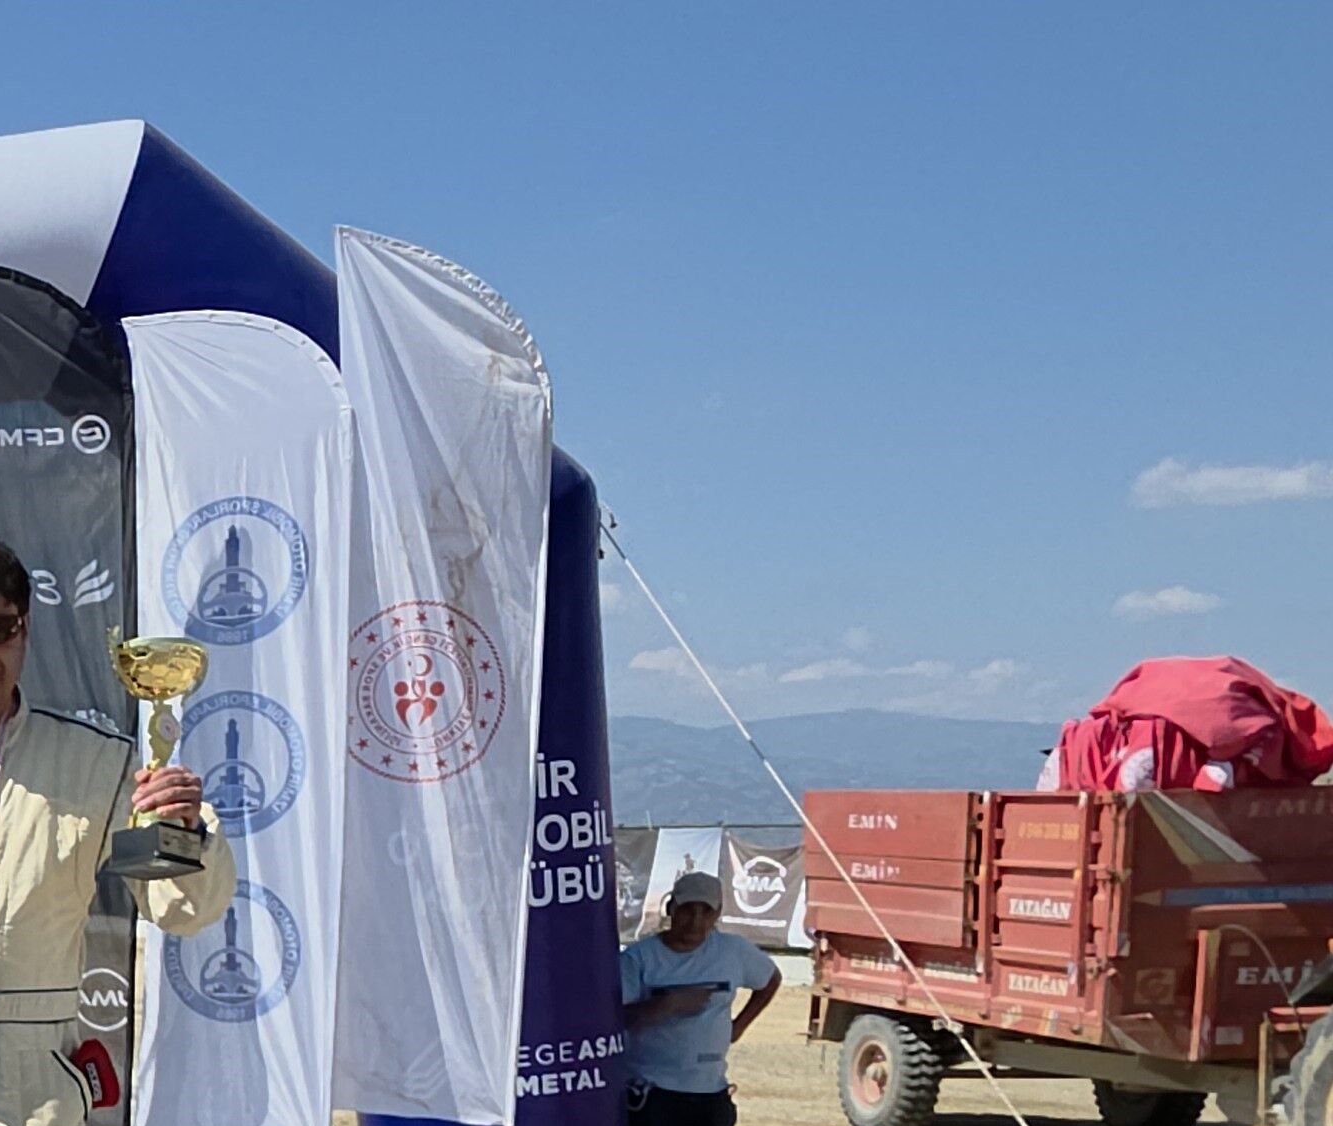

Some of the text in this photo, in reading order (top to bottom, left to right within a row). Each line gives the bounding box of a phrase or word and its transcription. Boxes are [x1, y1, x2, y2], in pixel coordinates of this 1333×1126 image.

[535, 752, 579, 799] İR
[536, 800, 613, 852] OBİL
[527, 854, 606, 908] ÜBÜ
[516, 1067, 606, 1098] METAL
